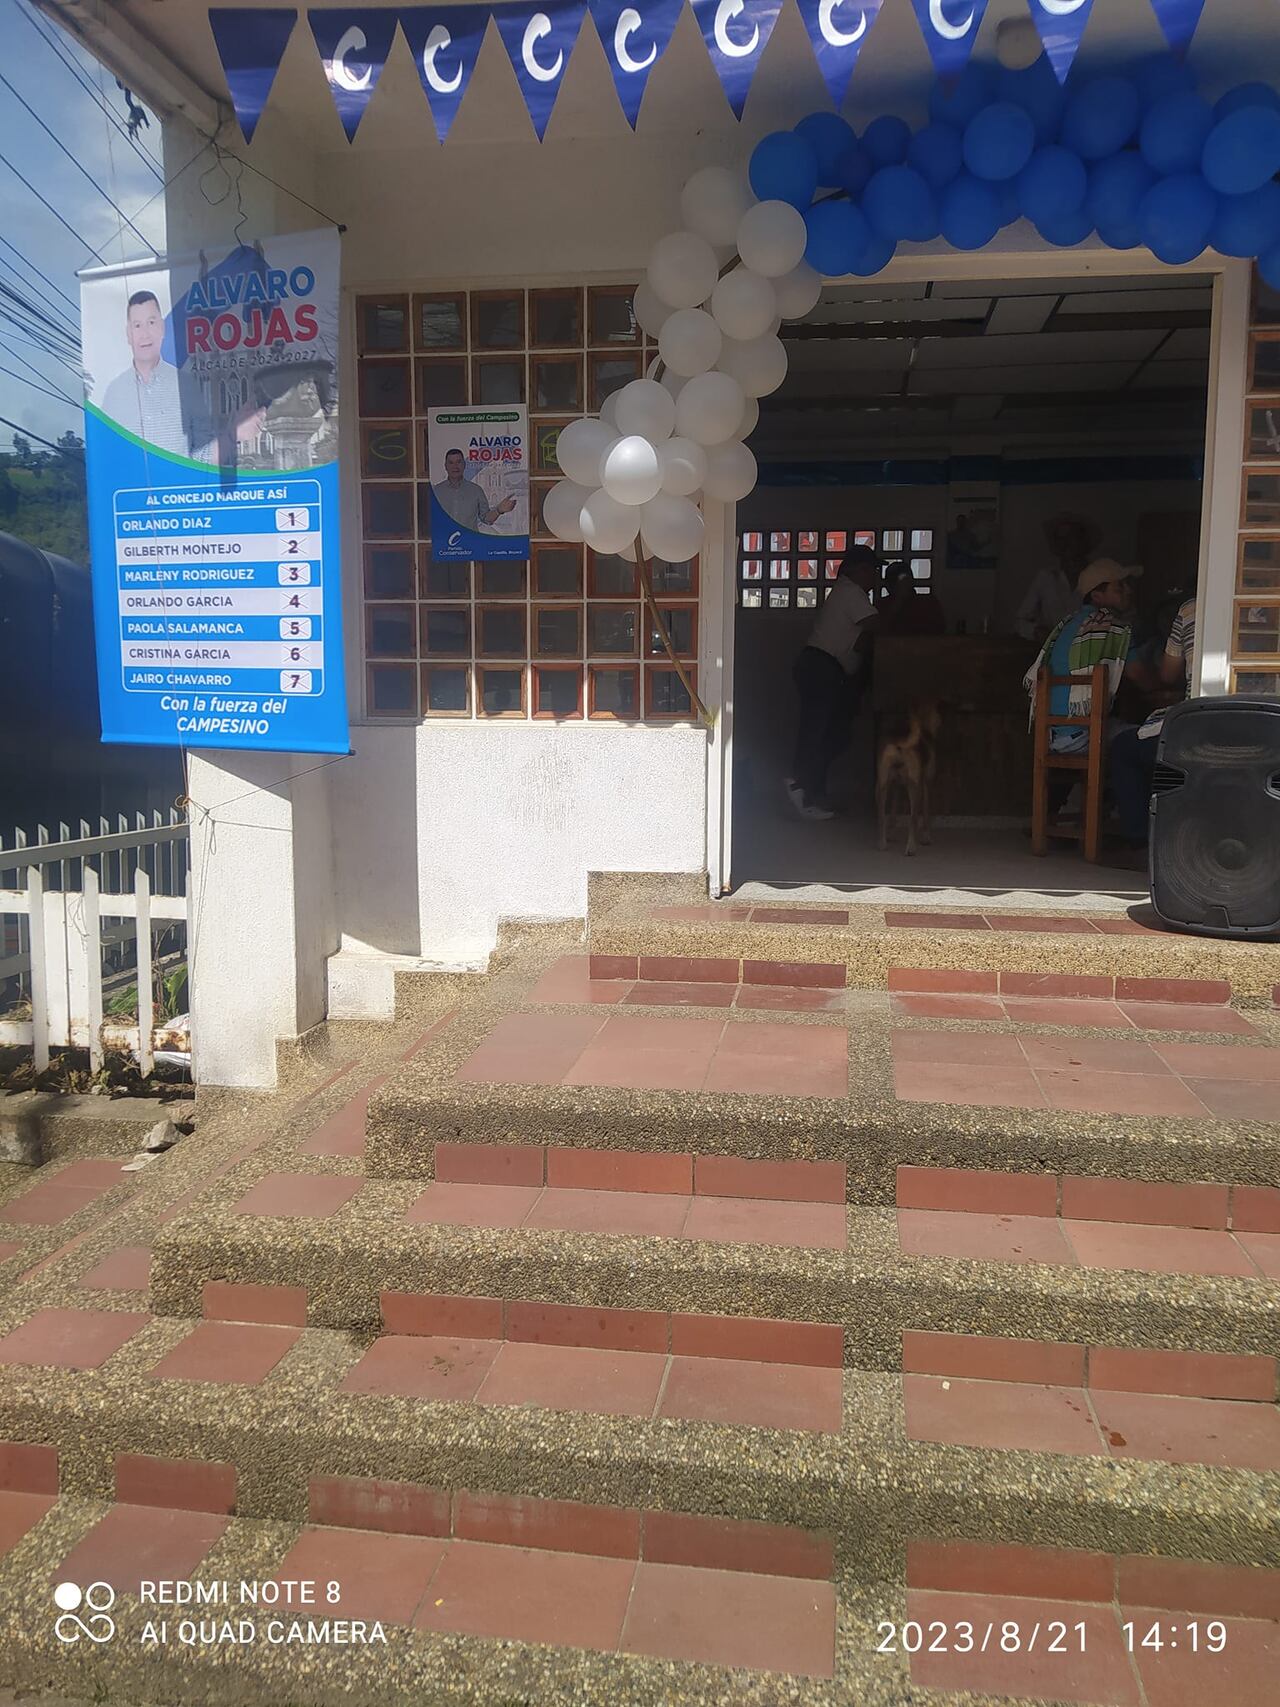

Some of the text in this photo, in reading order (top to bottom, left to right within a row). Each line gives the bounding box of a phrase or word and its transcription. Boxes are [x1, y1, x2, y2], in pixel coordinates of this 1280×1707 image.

[522, 12, 563, 82] C
[615, 8, 657, 73] C
[332, 26, 372, 91] C
[423, 24, 463, 93] C
[186, 266, 315, 311] ALVARO
[187, 304, 318, 354] ROJAS
[191, 350, 317, 371] ALCALDE 2024-2027
[469, 436, 522, 447] ALVARO
[469, 448, 523, 461] ROJAS
[146, 487, 287, 506] AL CONCEJO MARQUE ASÍ
[122, 512, 296, 531] ORLANDO DIAZ 1
[124, 540, 299, 557] GILBERTH MONTEJO 2
[125, 567, 299, 582] MARLENY RODRIGUEZ 3
[126, 594, 300, 608] ORLANDO GARCIA 4
[128, 621, 300, 636] PAOLA SALAMANCA 5
[129, 647, 300, 661] CRISTINA GARCIA 6
[130, 673, 300, 688] JAIRO CHAVARRO 7
[160, 696, 287, 713] Con la fuerza del
[176, 717, 269, 735] CAMPESINO
